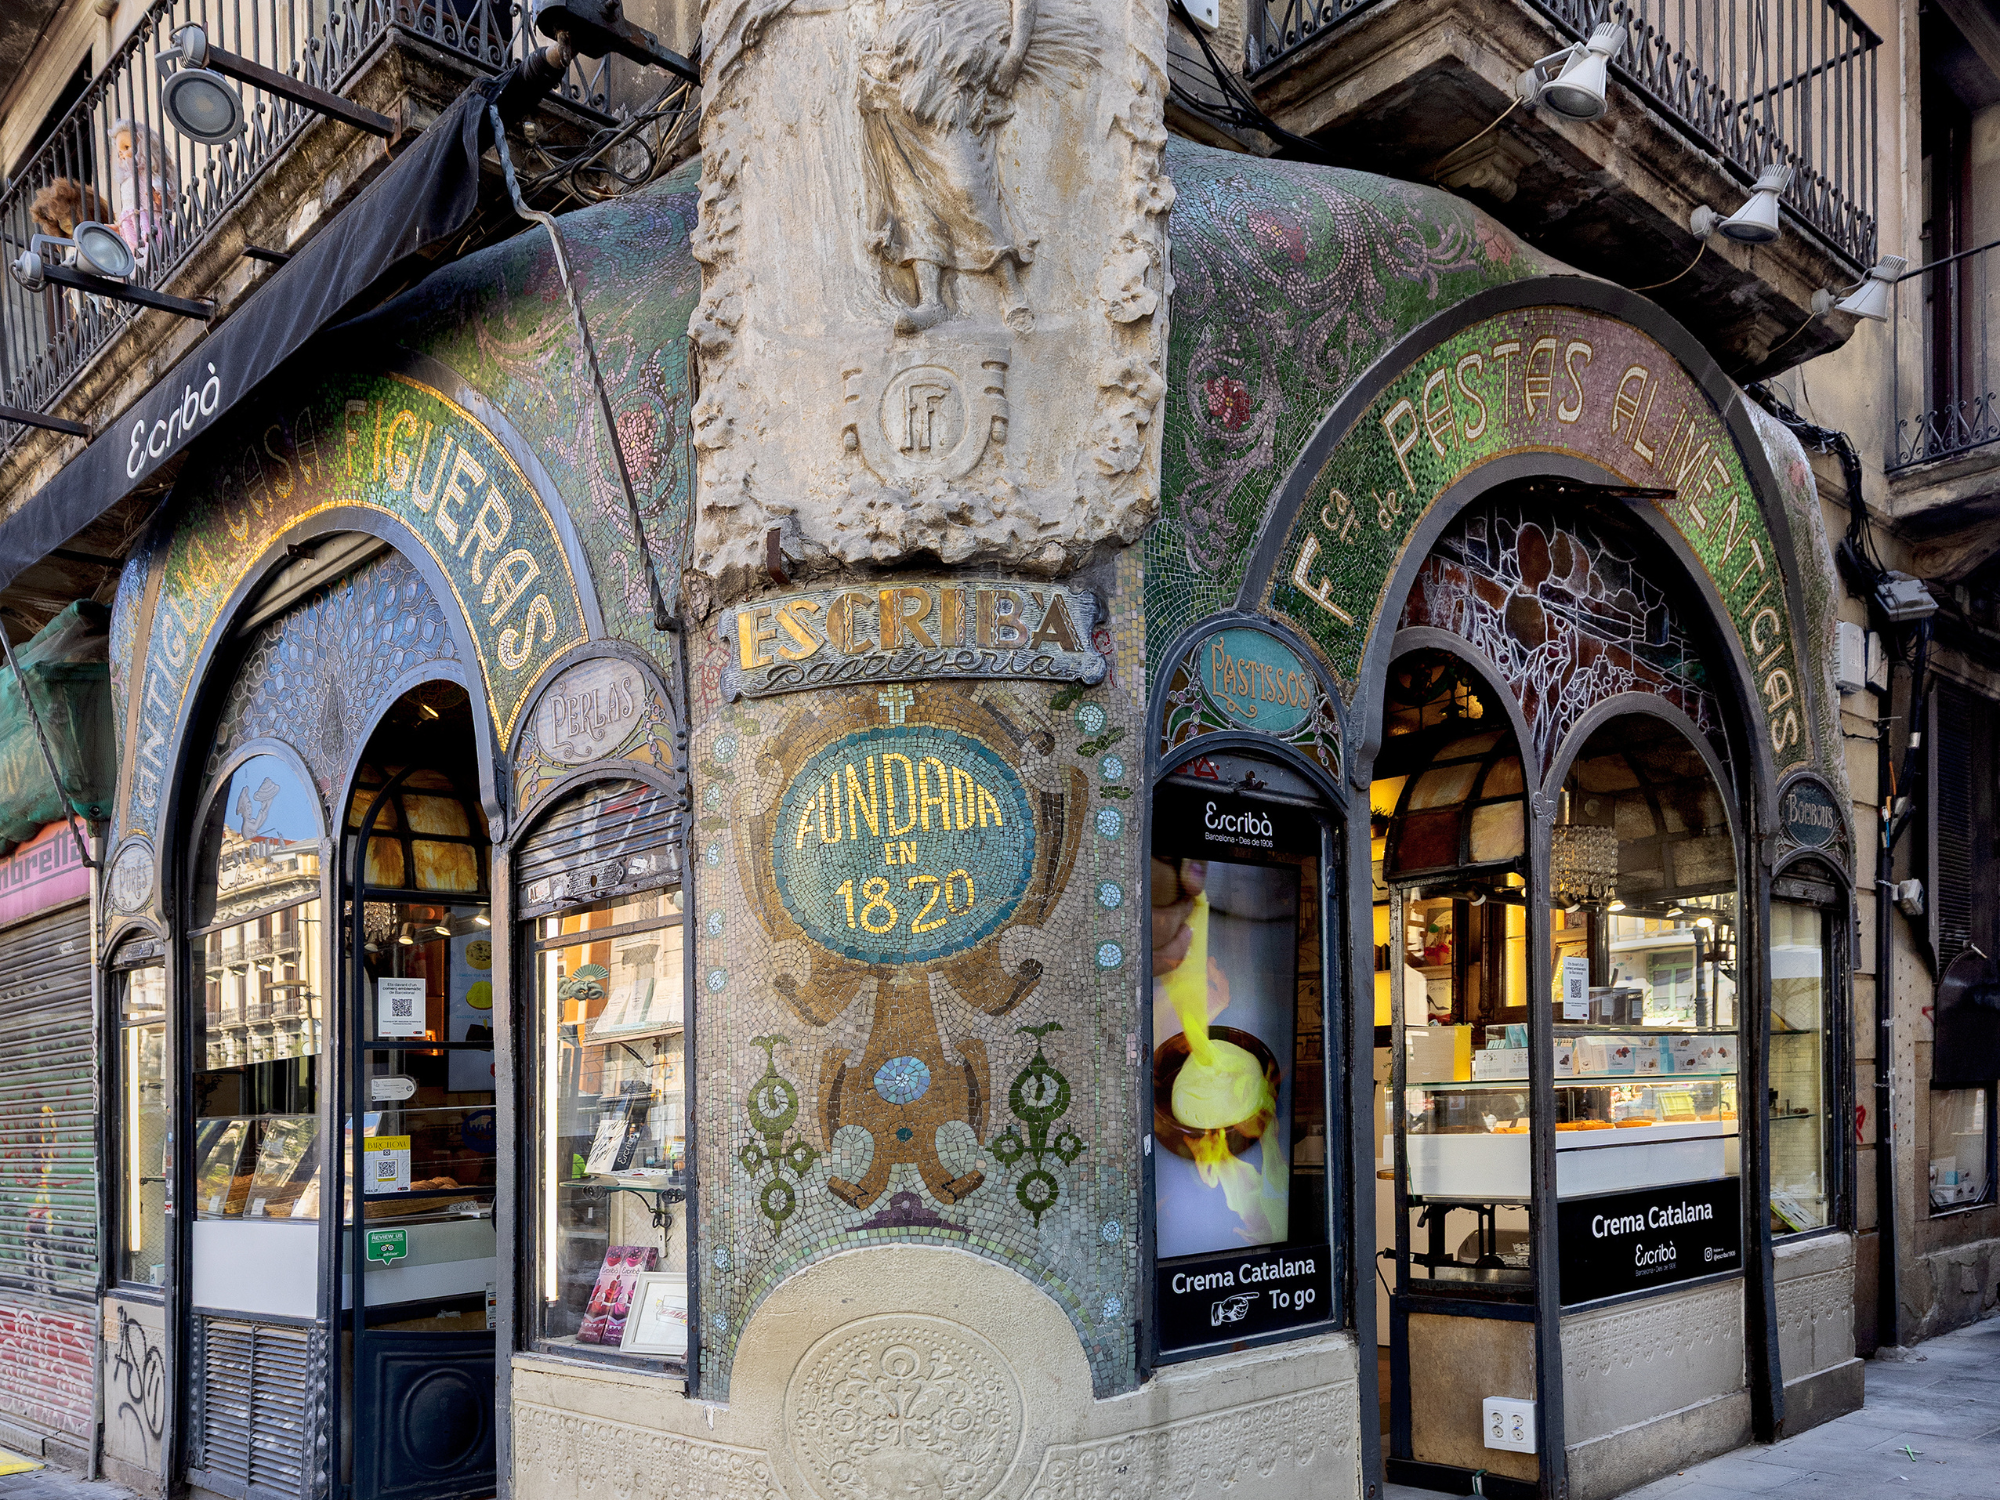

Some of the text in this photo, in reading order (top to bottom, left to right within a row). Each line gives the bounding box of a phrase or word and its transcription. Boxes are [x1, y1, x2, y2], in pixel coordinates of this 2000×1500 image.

[221, 406, 321, 542] CASA
[344, 399, 557, 671] FIGUERAS
[1378, 334, 1594, 495] PASTAS
[1610, 363, 1799, 754] ALIMENTICIAS
[1211, 636, 1310, 718] PASTISSOS
[550, 676, 634, 758] PERLAS
[796, 751, 1004, 850] FUNDADA
[1205, 801, 1273, 837] Escribà
[884, 841, 918, 866] EN
[1204, 832, 1235, 844] Barcelona
[1239, 836, 1251, 845] Des
[1251, 839, 1260, 847] de
[833, 867, 975, 935] 1820
[1591, 1201, 1714, 1238] Crema Catalana
[1635, 1240, 1677, 1266] Escribà
[1172, 1258, 1316, 1294] Crema Catalana
[1268, 1288, 1316, 1310] To go
